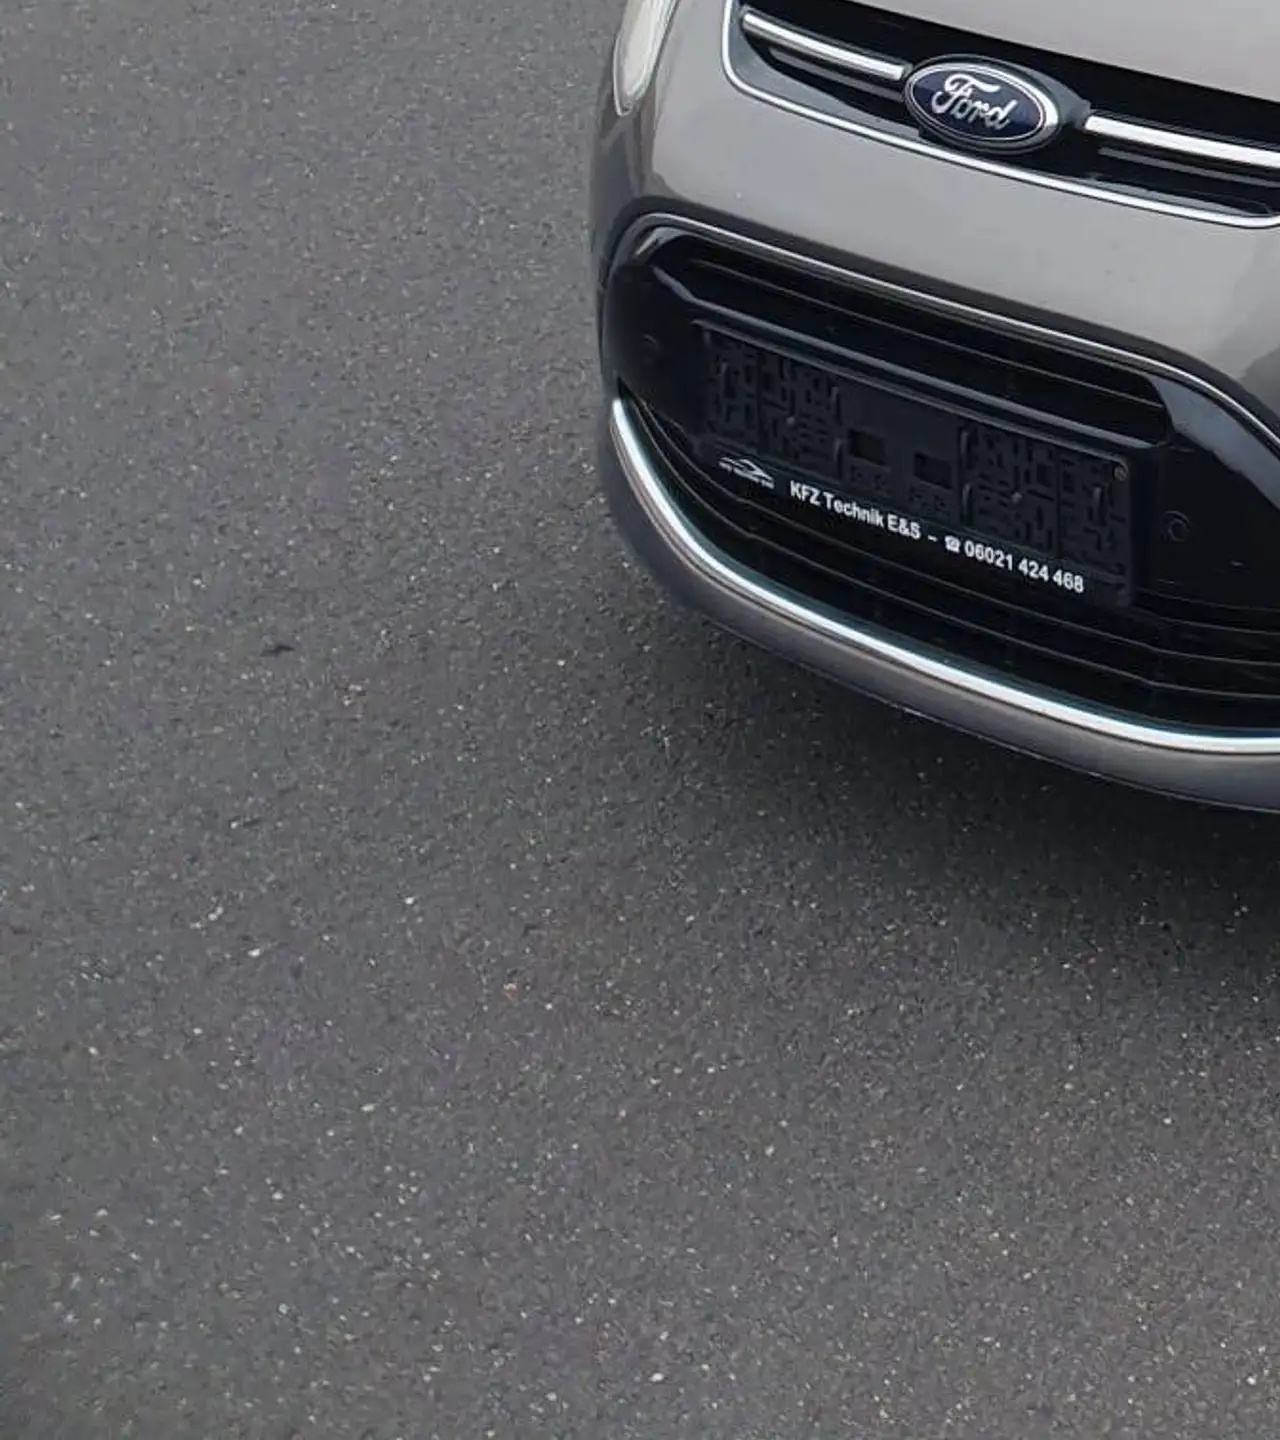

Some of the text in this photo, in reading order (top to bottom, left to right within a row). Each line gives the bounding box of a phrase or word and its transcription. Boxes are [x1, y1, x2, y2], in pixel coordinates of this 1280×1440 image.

[931, 72, 1018, 131] Ford
[790, 480, 821, 506] KFZ
[822, 491, 885, 527] Technik
[887, 513, 921, 540] E&S
[963, 539, 1014, 571] 06021
[1018, 558, 1050, 582] 424
[1052, 569, 1085, 594] 468
